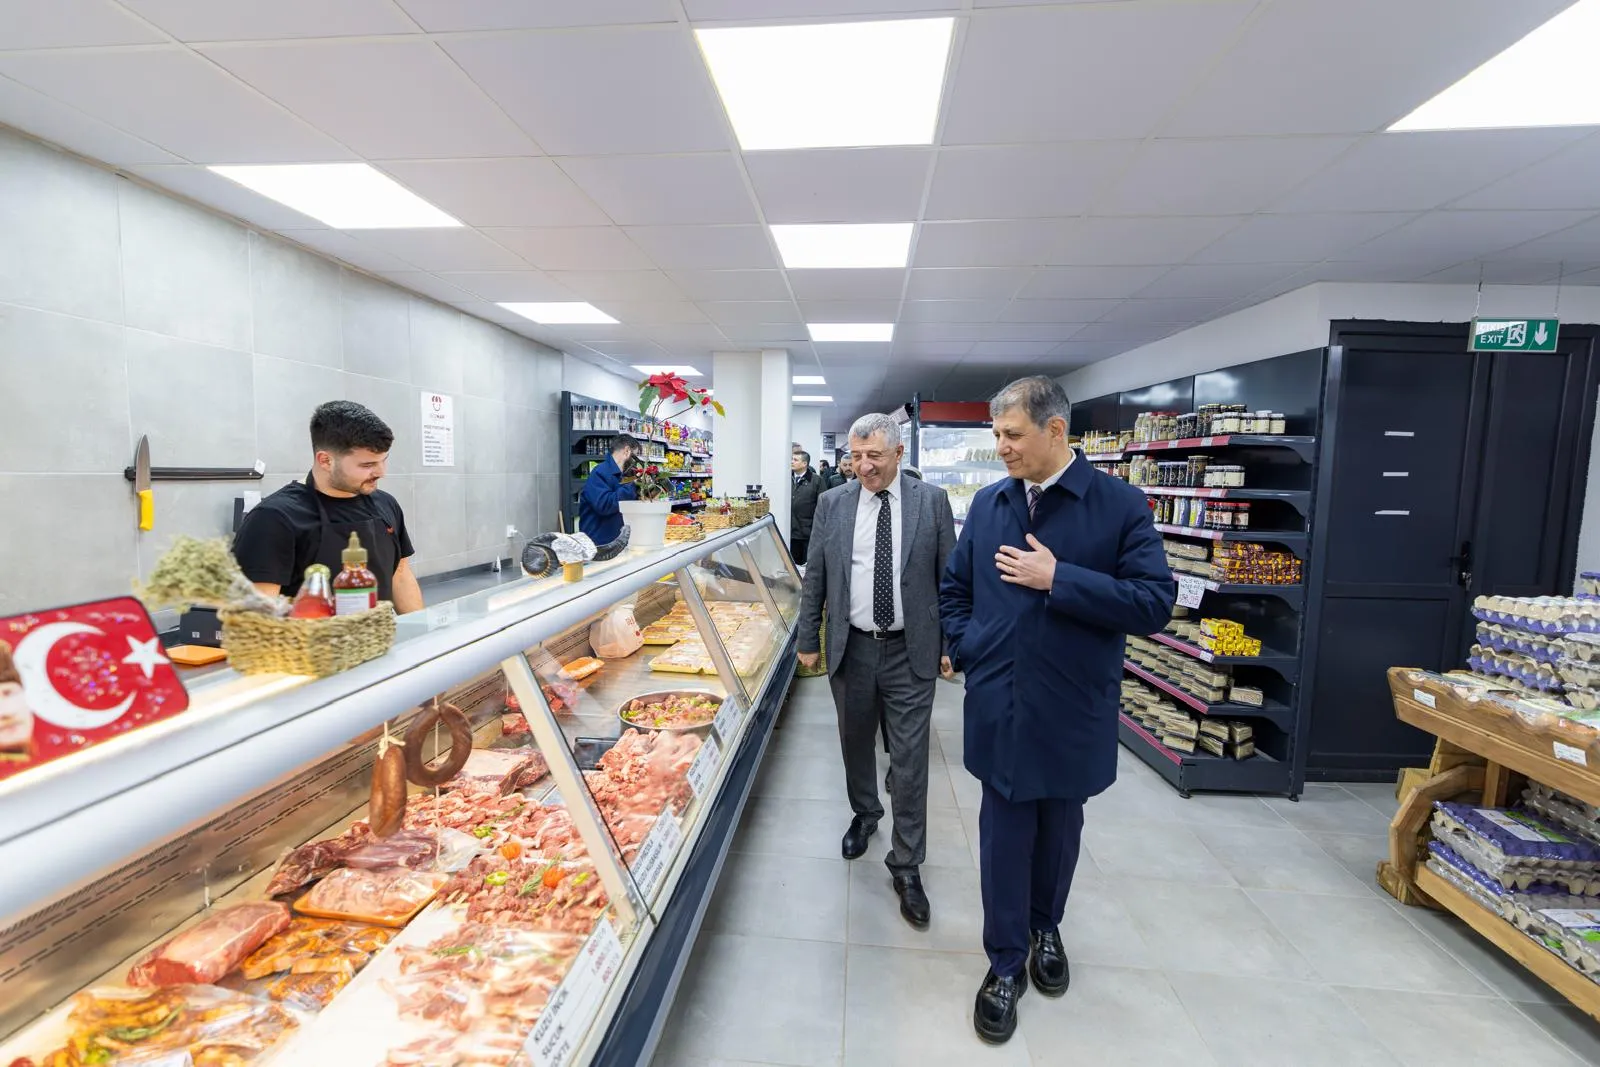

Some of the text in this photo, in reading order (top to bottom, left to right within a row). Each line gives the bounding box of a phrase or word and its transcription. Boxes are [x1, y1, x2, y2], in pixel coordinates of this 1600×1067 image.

[1480, 335, 1504, 344] EXIT
[534, 1012, 552, 1044] KUZU
[542, 1022, 565, 1060] SUCUK
